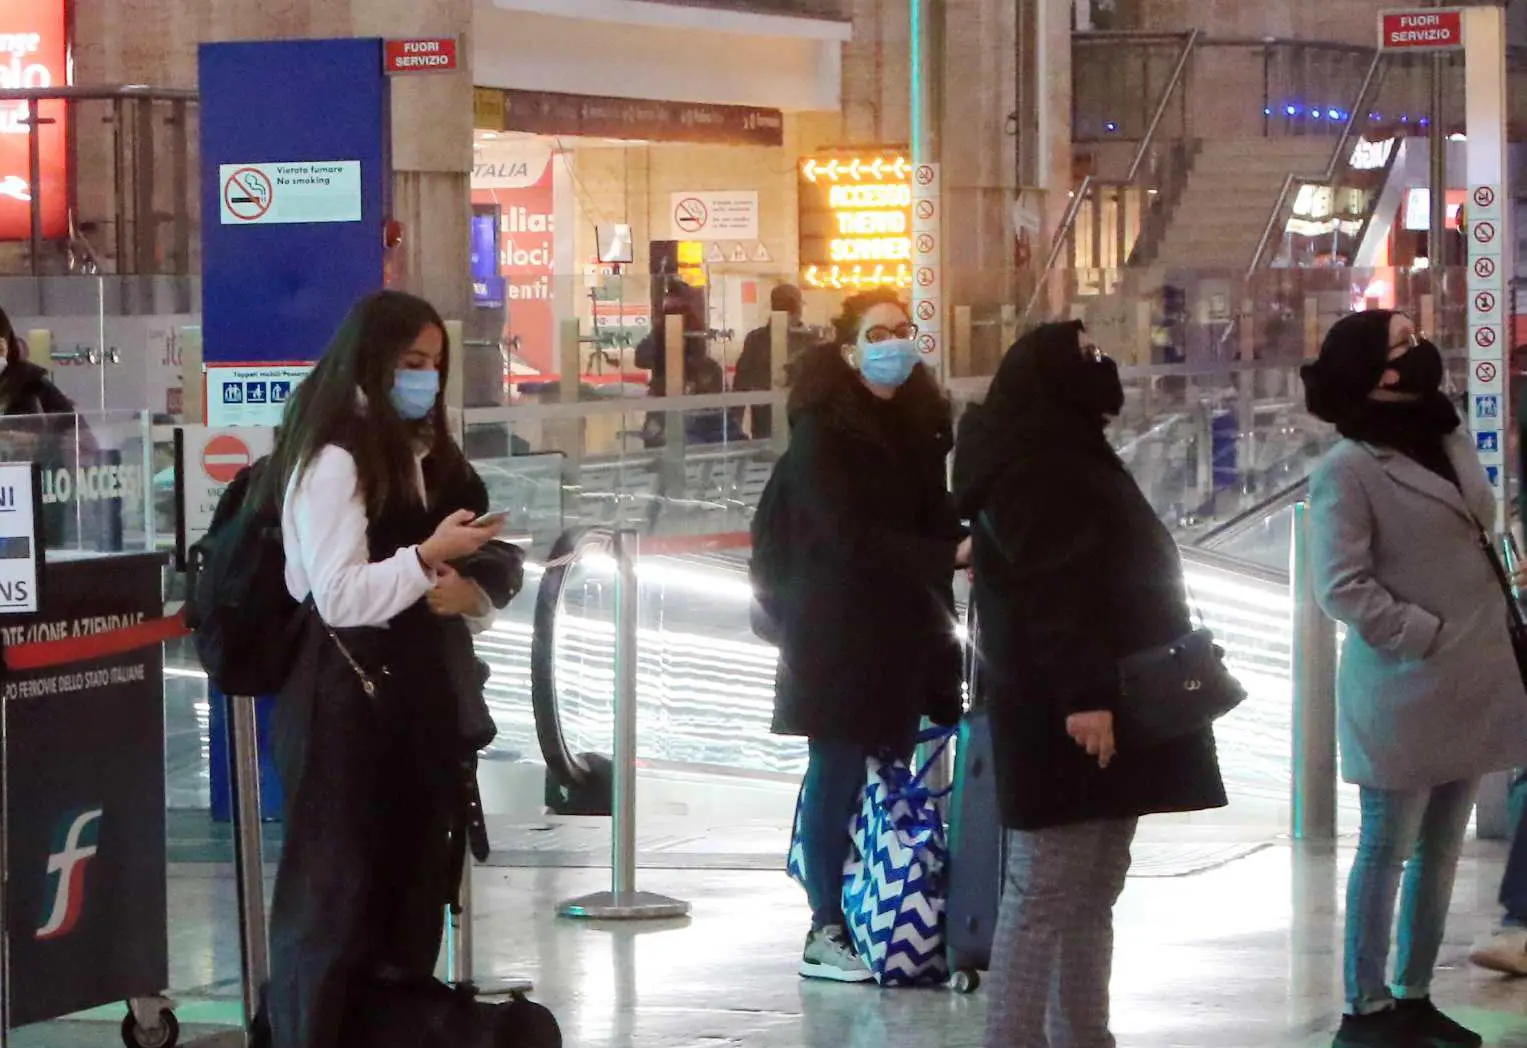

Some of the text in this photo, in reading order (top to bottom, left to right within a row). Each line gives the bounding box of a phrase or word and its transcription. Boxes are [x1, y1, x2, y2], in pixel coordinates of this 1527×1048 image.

[1400, 15, 1439, 27] FUORI
[1390, 28, 1451, 42] SERVIZIO
[403, 41, 440, 53] FUORI
[395, 55, 449, 67] SERVIZIO
[276, 165, 343, 175] Vietato fumare
[277, 177, 331, 186] No smoking
[829, 184, 911, 208] ACCESSO
[40, 468, 71, 504] LLO
[18, 676, 57, 698] FERROVIE
[58, 673, 84, 692] DELLO
[85, 669, 109, 688] STATO
[110, 663, 144, 684] ITALIANE
